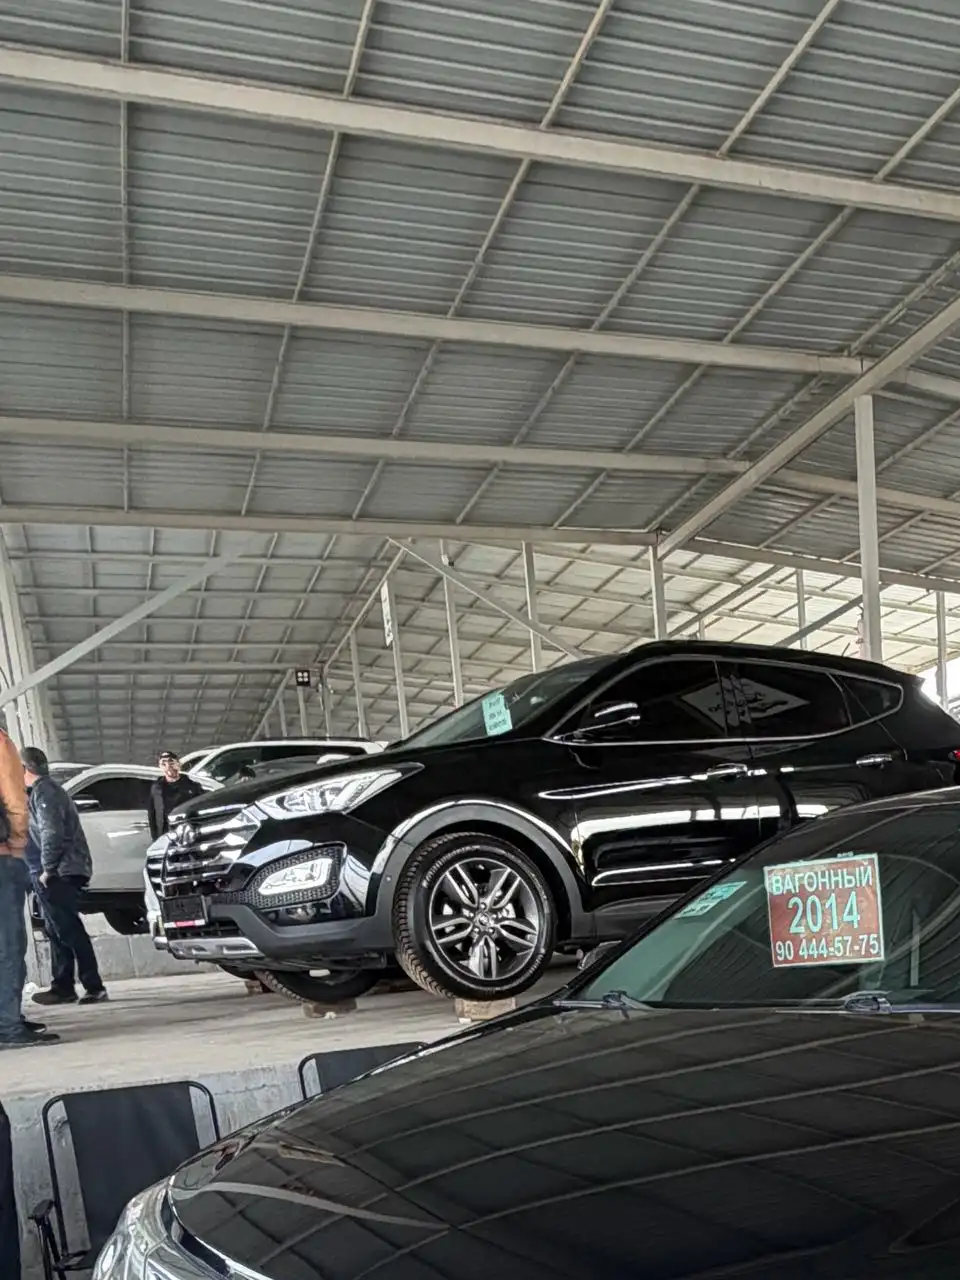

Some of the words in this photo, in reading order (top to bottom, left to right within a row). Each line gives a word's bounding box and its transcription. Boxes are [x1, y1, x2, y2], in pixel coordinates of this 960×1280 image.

[772, 861, 873, 895] ВАГОННЫЙ
[788, 891, 860, 934] 2014
[775, 940, 794, 961] 90
[798, 934, 879, 959] 444-57-75
